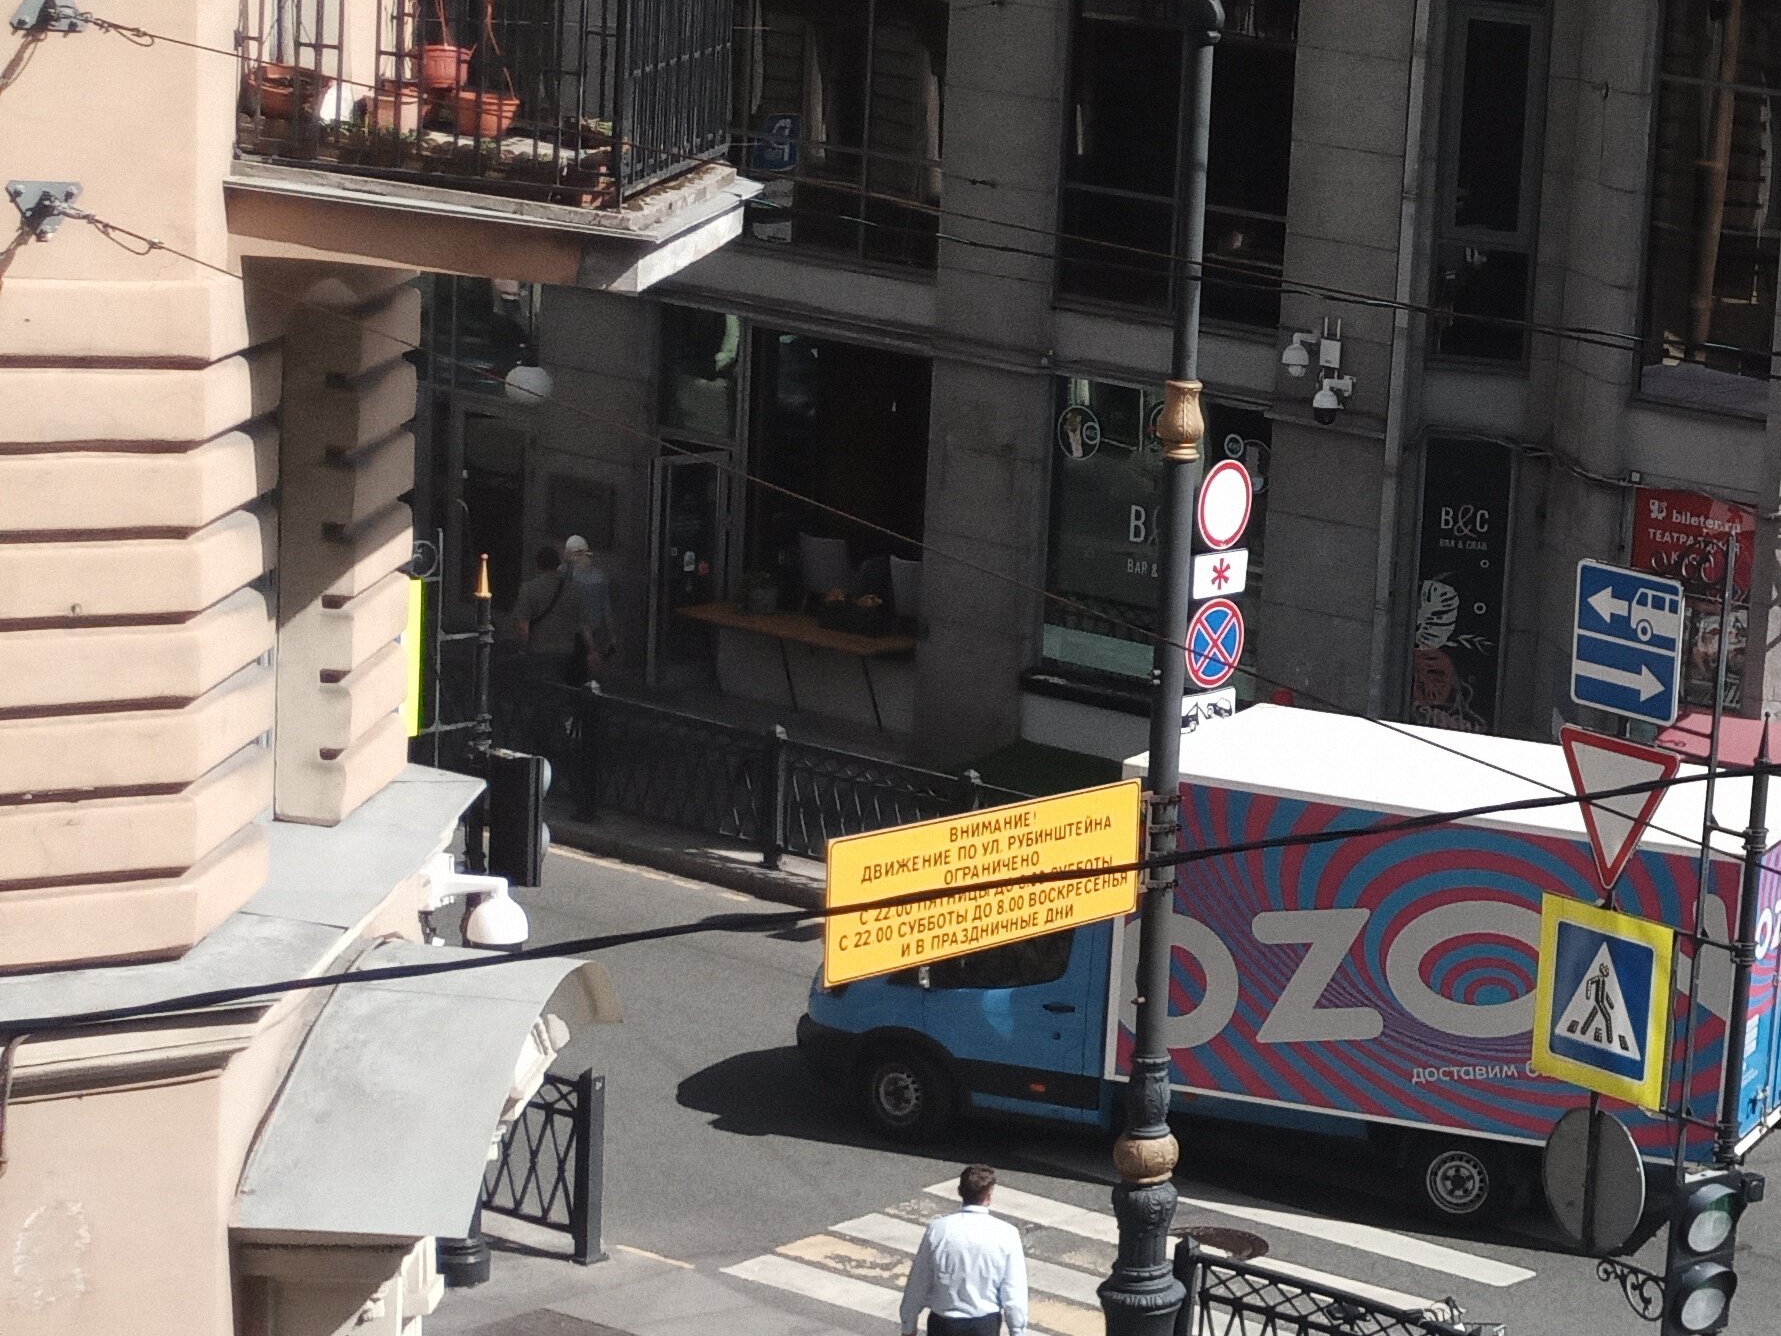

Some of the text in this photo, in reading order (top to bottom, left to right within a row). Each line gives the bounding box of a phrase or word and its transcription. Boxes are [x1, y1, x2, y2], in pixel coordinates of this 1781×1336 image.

[1440, 504, 1489, 538] B&C
[1127, 558, 1148, 575] BAR
[949, 811, 1037, 843] ВНИМАНИЕ!
[861, 815, 1112, 884] ДВИЖЕНИЕ ПО УЛ. РУБИНШТЕЙНА
[944, 851, 1040, 886] ОГРАНИЧЕНО
[838, 871, 1128, 952] С 22.00 СУББОТЫ ДО 8.00 ВОСКРЕСЕНЬЯ
[859, 908, 867, 926] С
[901, 904, 1074, 959] И В ПРАЗДНИЧНЫЕ ДНИ
[1412, 1065, 1519, 1085] доставим
